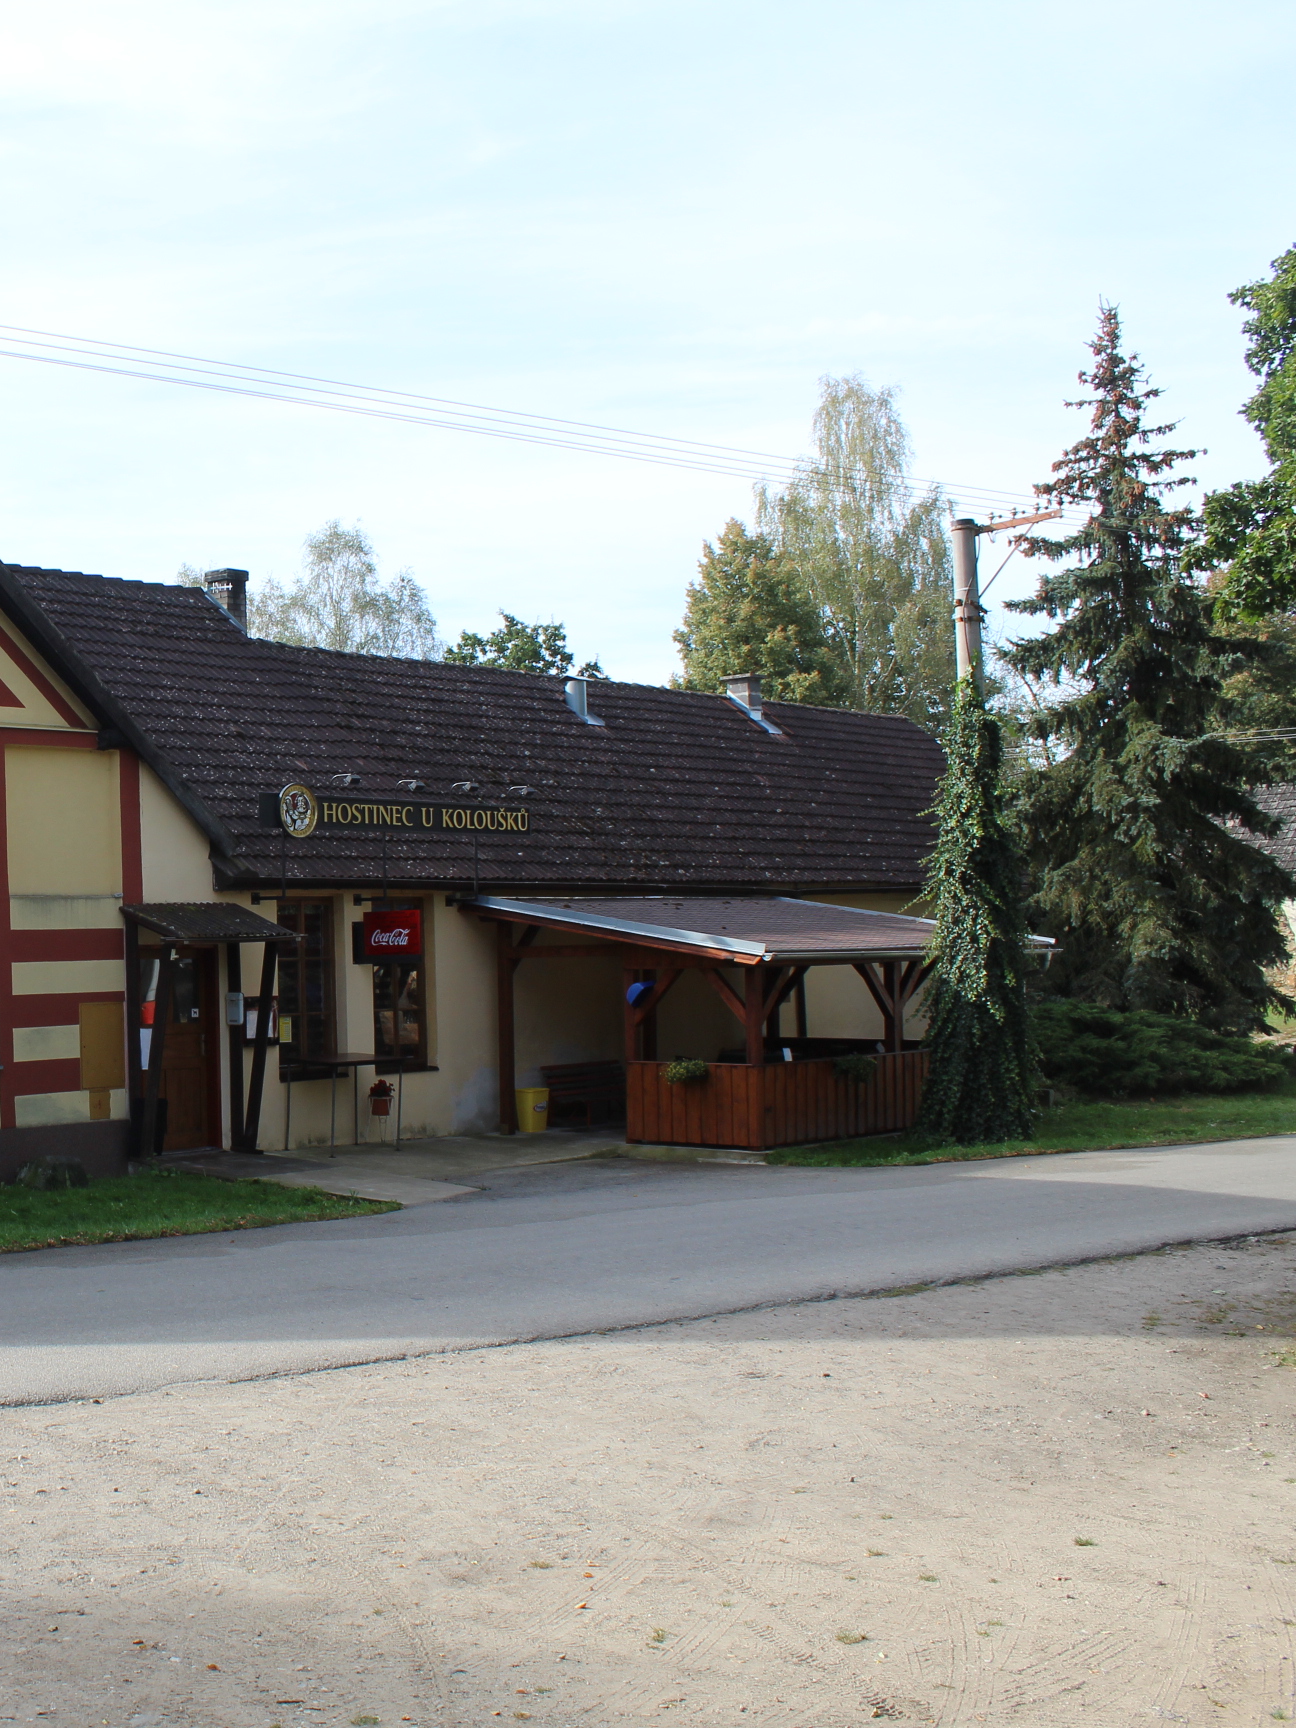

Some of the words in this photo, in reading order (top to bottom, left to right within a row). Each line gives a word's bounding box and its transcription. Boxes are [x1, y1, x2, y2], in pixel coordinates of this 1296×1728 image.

[322, 802, 414, 827] HOSTINEC
[421, 807, 434, 828] U
[442, 808, 529, 832] KOLOUŠKŮ
